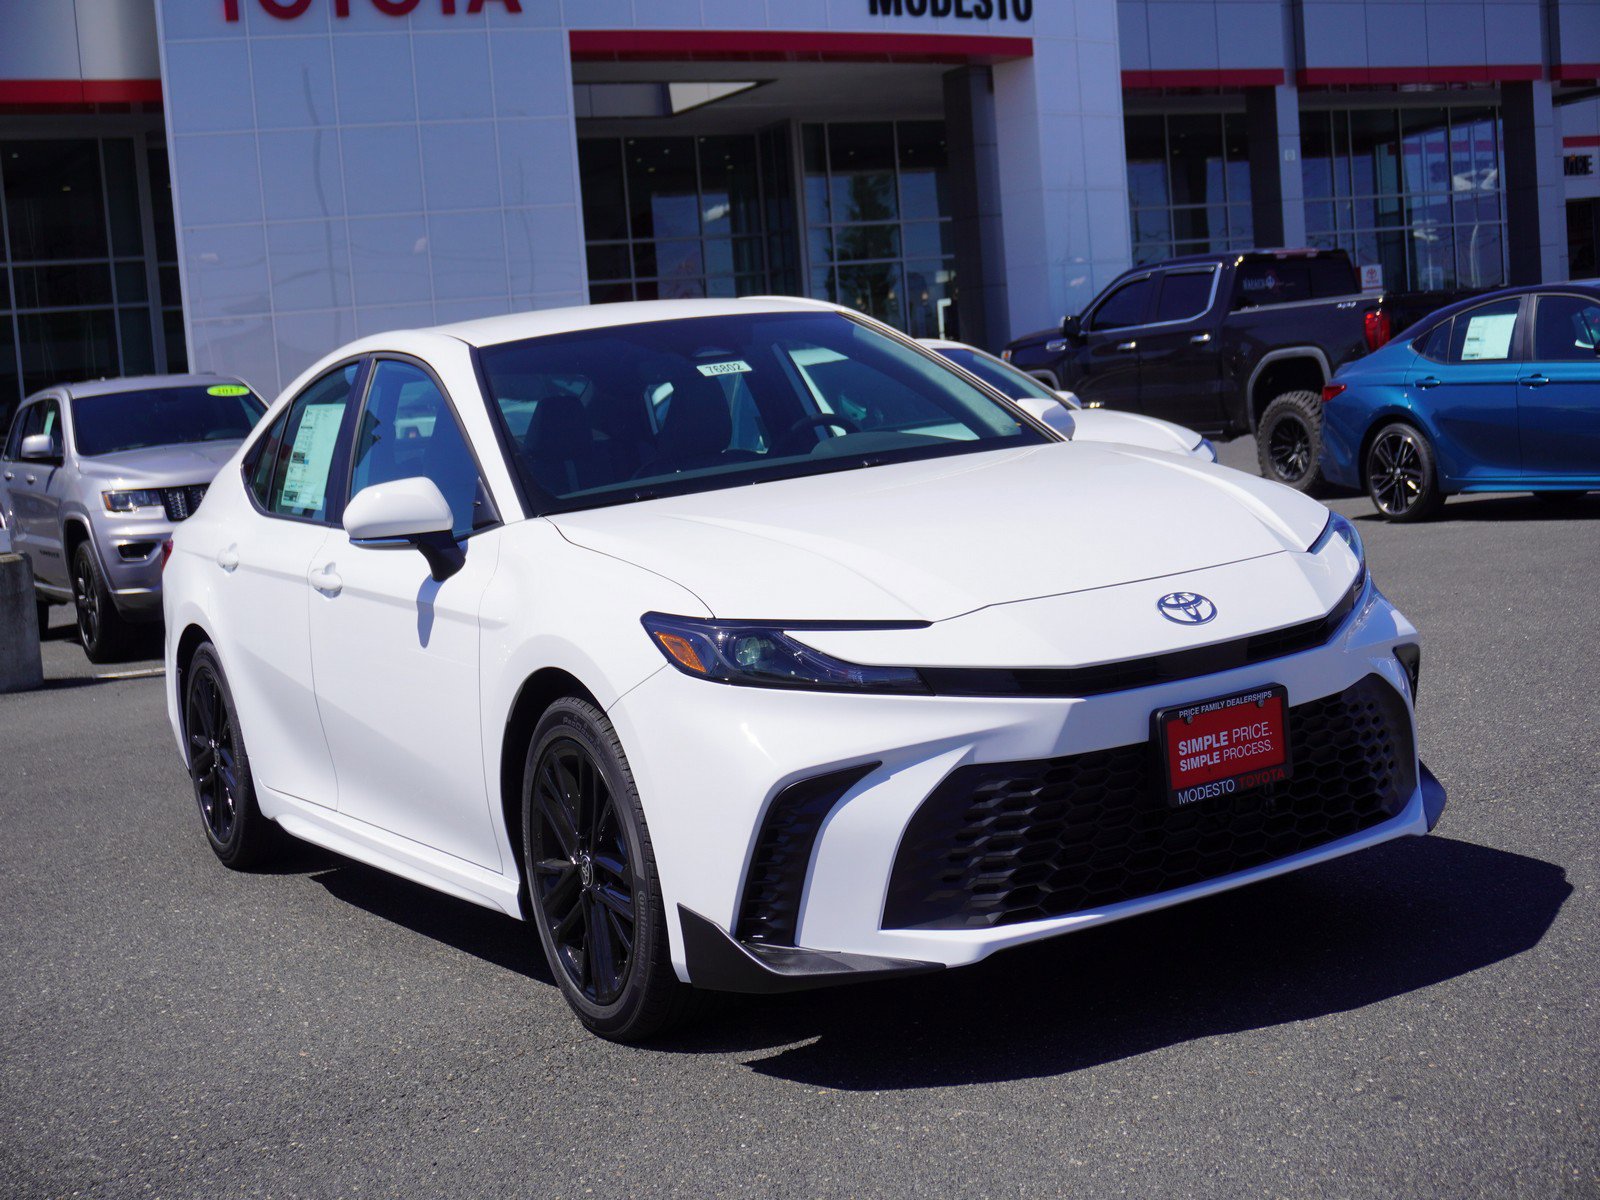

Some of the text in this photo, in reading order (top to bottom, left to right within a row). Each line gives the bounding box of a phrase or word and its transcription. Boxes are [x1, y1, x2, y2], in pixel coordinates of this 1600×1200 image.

[705, 363, 744, 374] 76802
[1178, 690, 1273, 718] PRICE FAMILY DEALERSHIPS
[1178, 721, 1273, 756] SIMPLE PRICE.
[1179, 739, 1274, 772] SIMPLE PROCESS.
[1178, 768, 1285, 805] MODESTO TOYOTA
